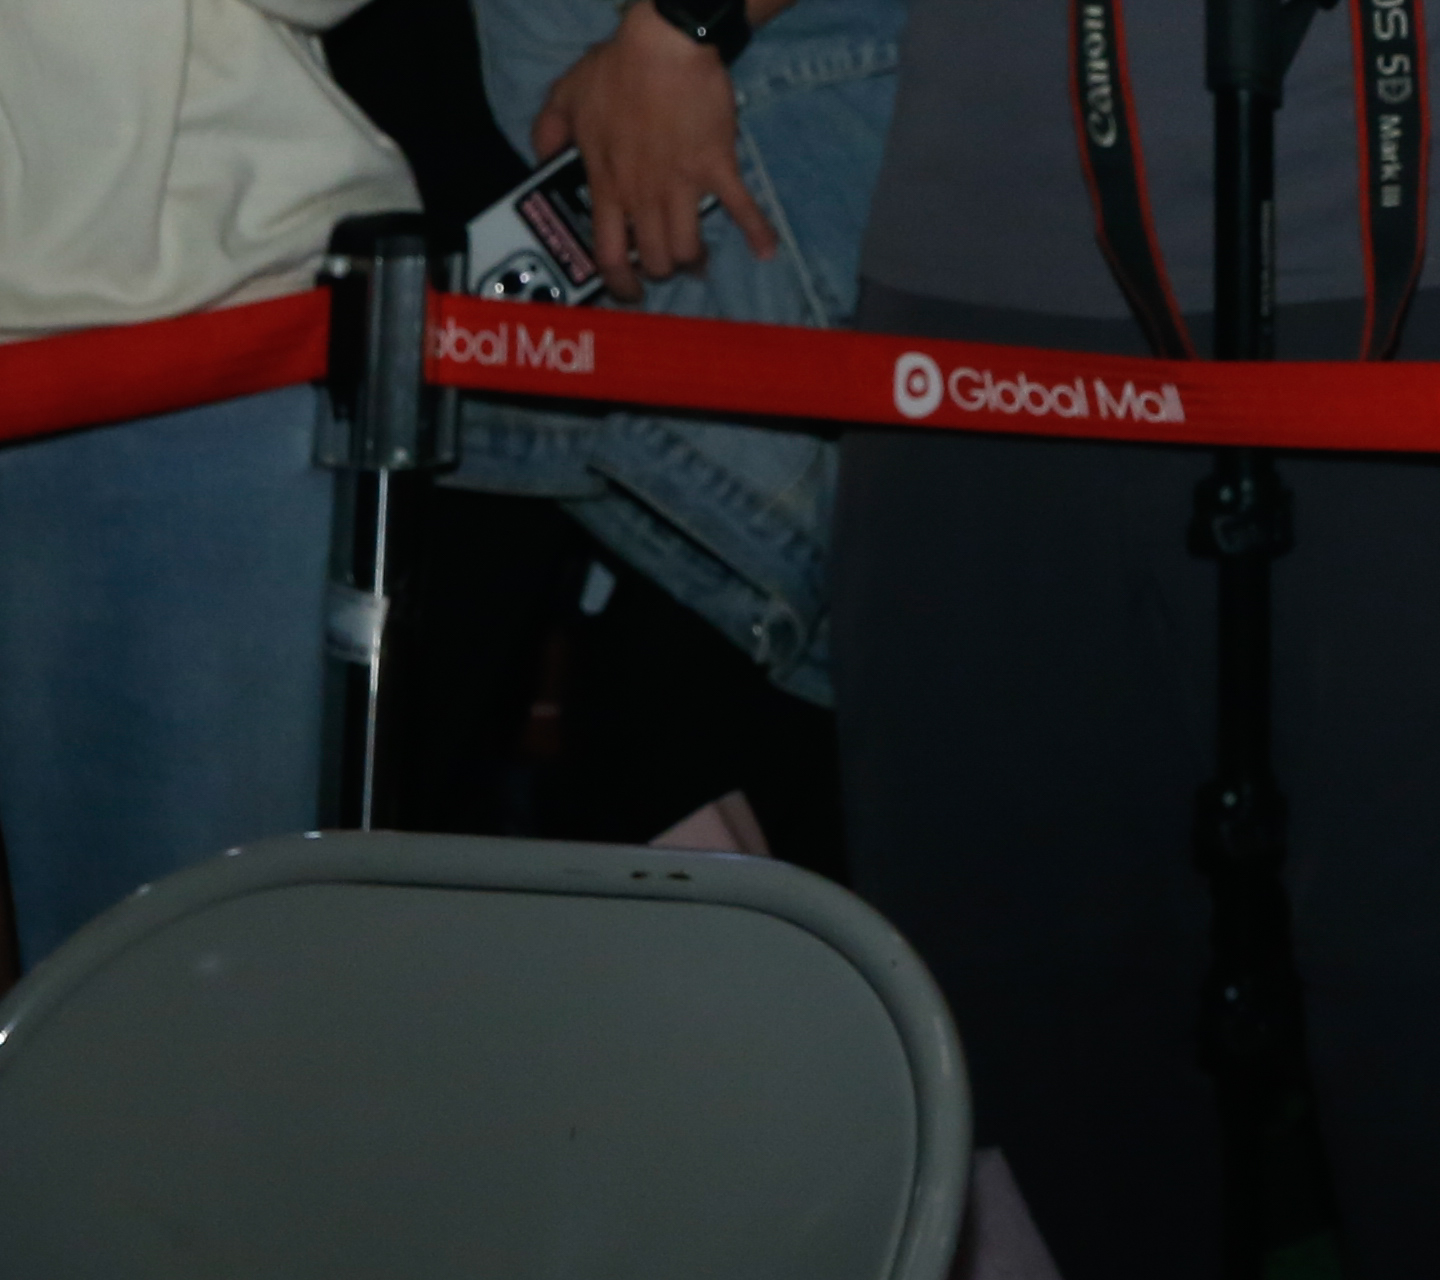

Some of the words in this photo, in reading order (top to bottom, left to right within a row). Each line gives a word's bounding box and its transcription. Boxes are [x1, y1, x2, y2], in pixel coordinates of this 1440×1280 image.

[1082, 4, 1117, 148] Canon
[1376, 53, 1412, 103] 5D
[1379, 114, 1402, 181] Mark
[515, 323, 595, 373] Mall
[948, 367, 1090, 419] Global
[1093, 376, 1186, 424] Mall
